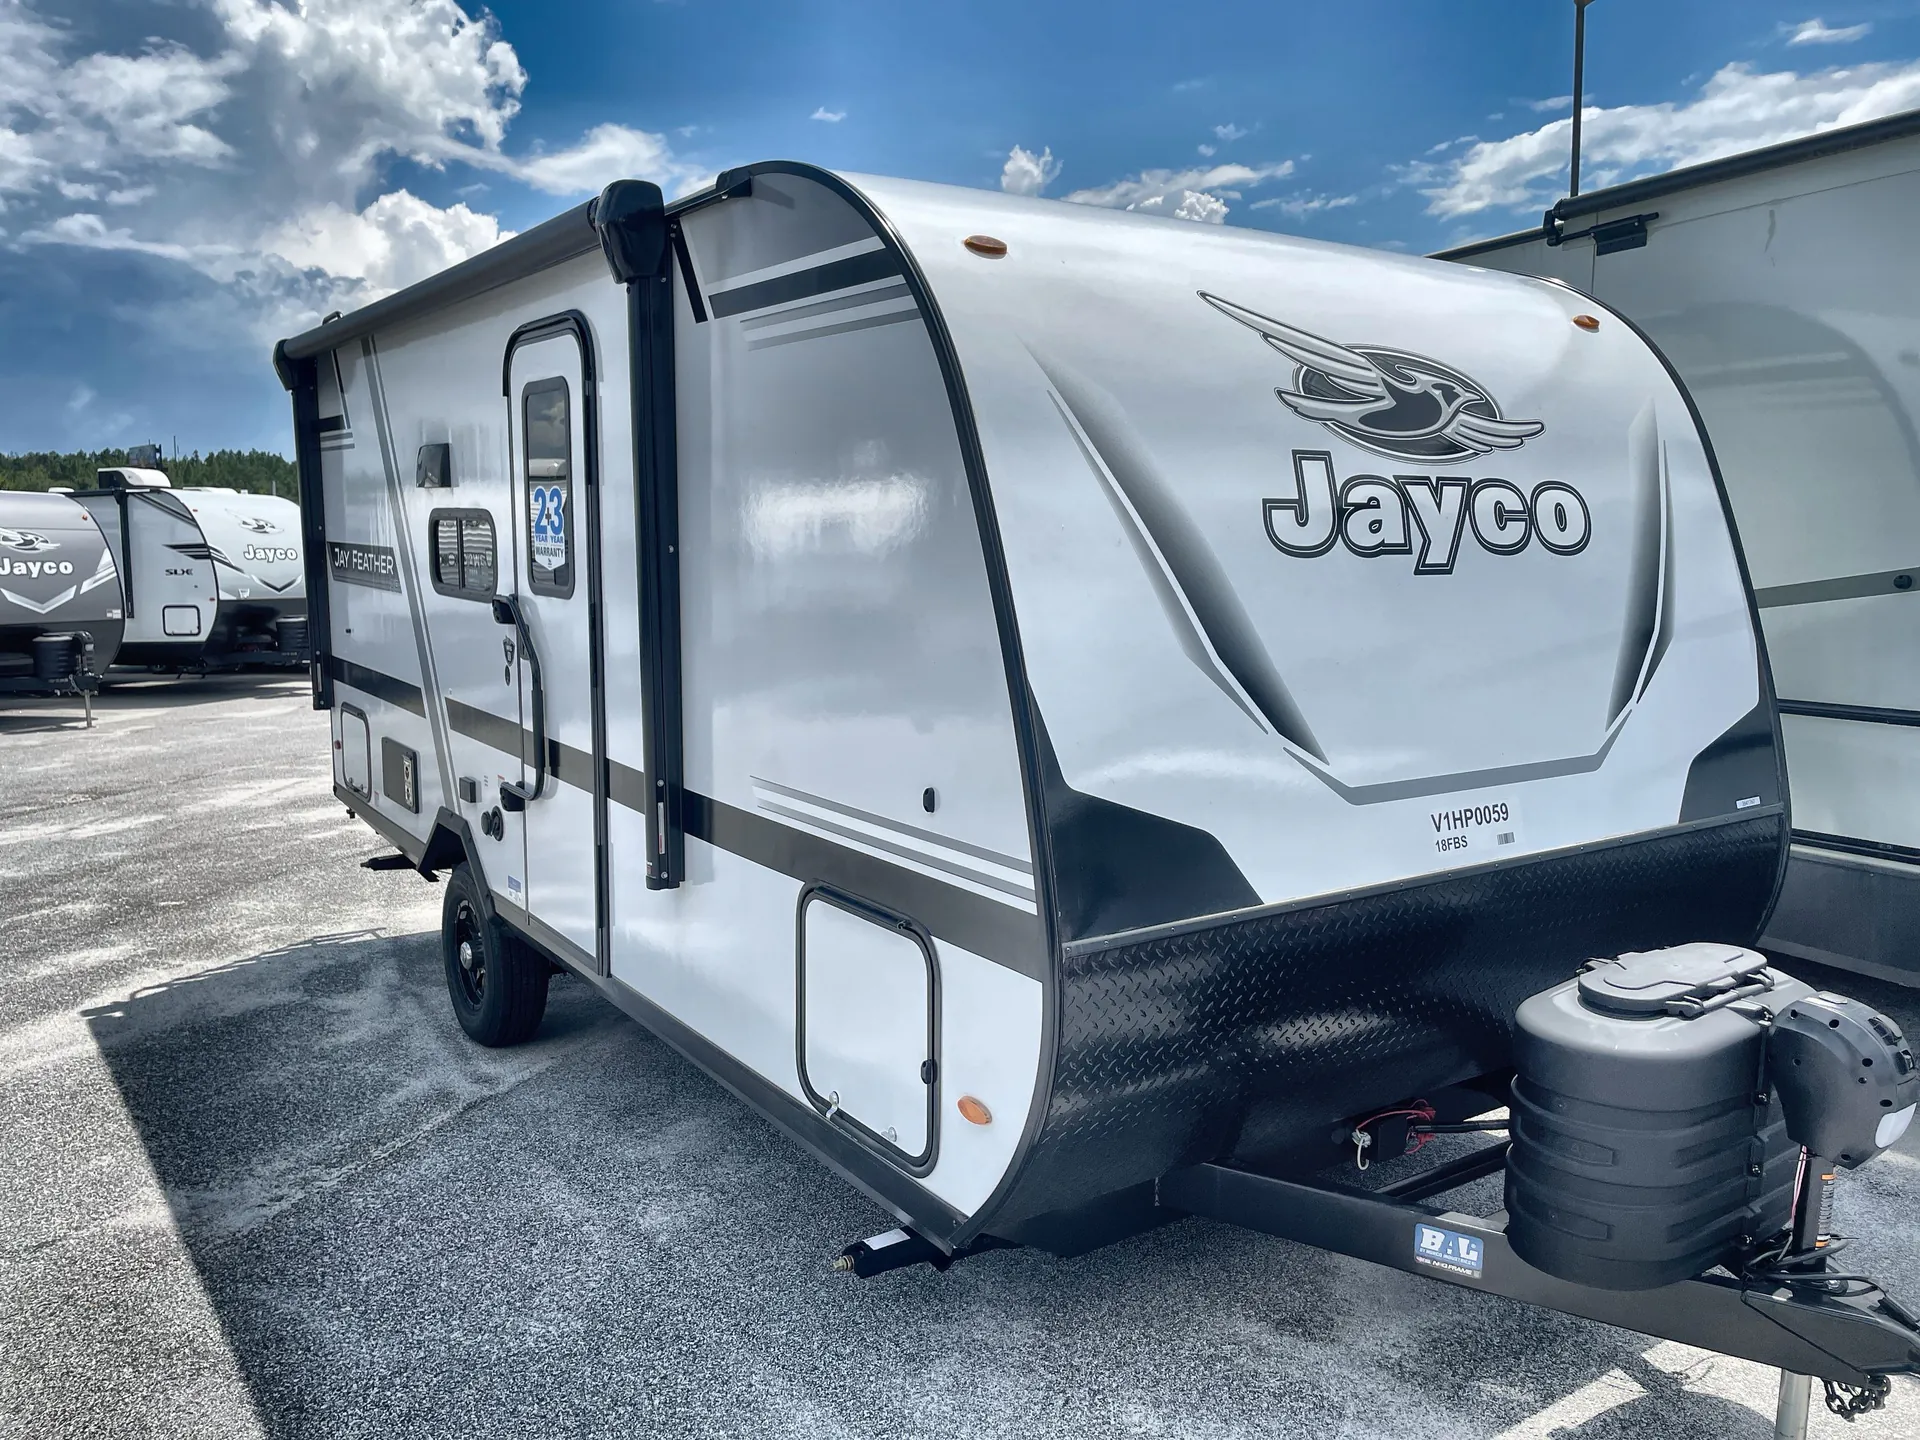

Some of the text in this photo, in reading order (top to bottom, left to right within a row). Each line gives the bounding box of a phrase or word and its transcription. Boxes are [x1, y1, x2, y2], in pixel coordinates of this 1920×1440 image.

[1262, 449, 1591, 575] Jayco
[243, 544, 298, 563] Jayco
[334, 547, 394, 575] JAY FEATHER
[535, 546, 564, 558] WARRANTY
[0, 556, 74, 579] Jayco
[1430, 802, 1509, 832] V1HP0059
[1435, 835, 1468, 852] 18FBS
[1420, 1227, 1478, 1261] BAL
